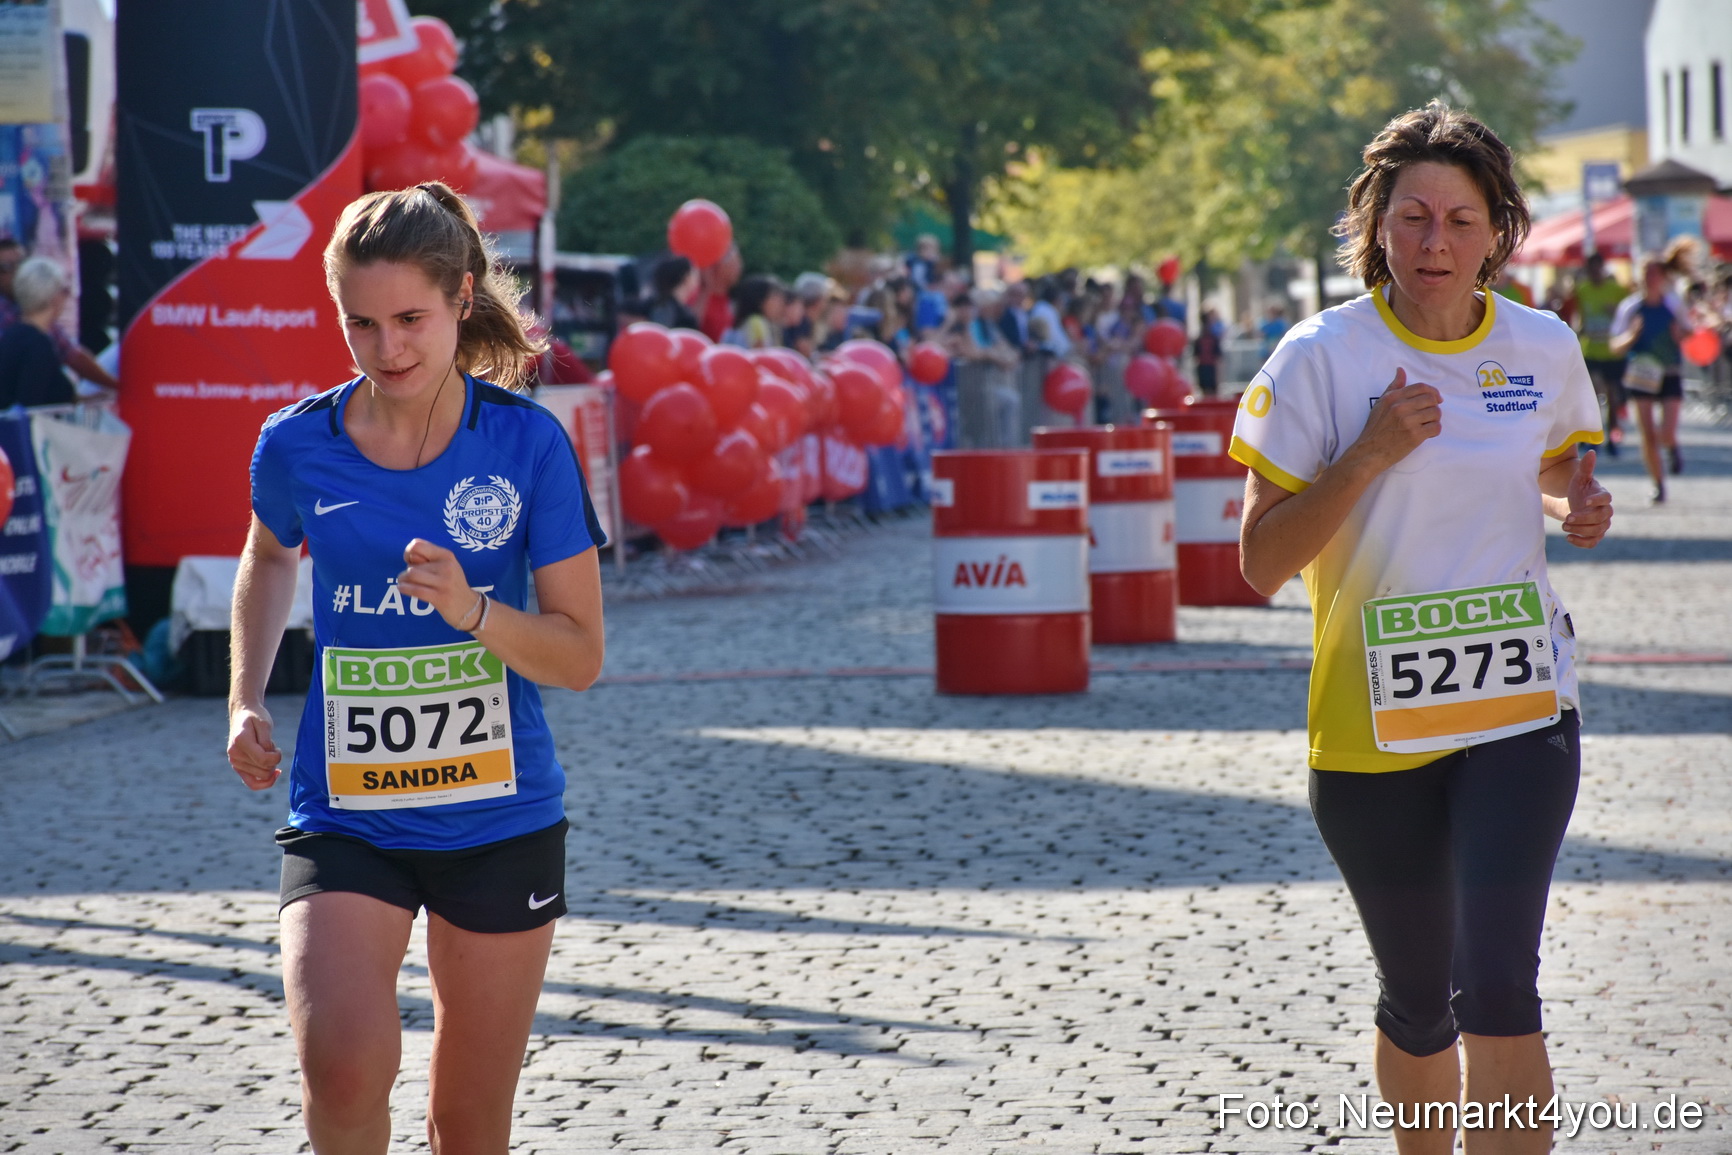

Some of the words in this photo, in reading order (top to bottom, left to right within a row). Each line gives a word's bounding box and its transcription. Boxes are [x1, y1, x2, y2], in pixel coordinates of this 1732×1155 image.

[152, 304, 206, 326] BMW
[209, 305, 317, 331] Laufsport
[1479, 368, 1507, 387] 20
[1510, 377, 1532, 385] JAHRE
[1486, 400, 1538, 413] Stadtlauf
[477, 516, 492, 527] 40
[1378, 589, 1532, 638] BOCK
[337, 648, 490, 690] BOCK
[1391, 638, 1532, 699] 5273
[347, 697, 488, 753] 5072
[362, 761, 478, 790] SANDRA
